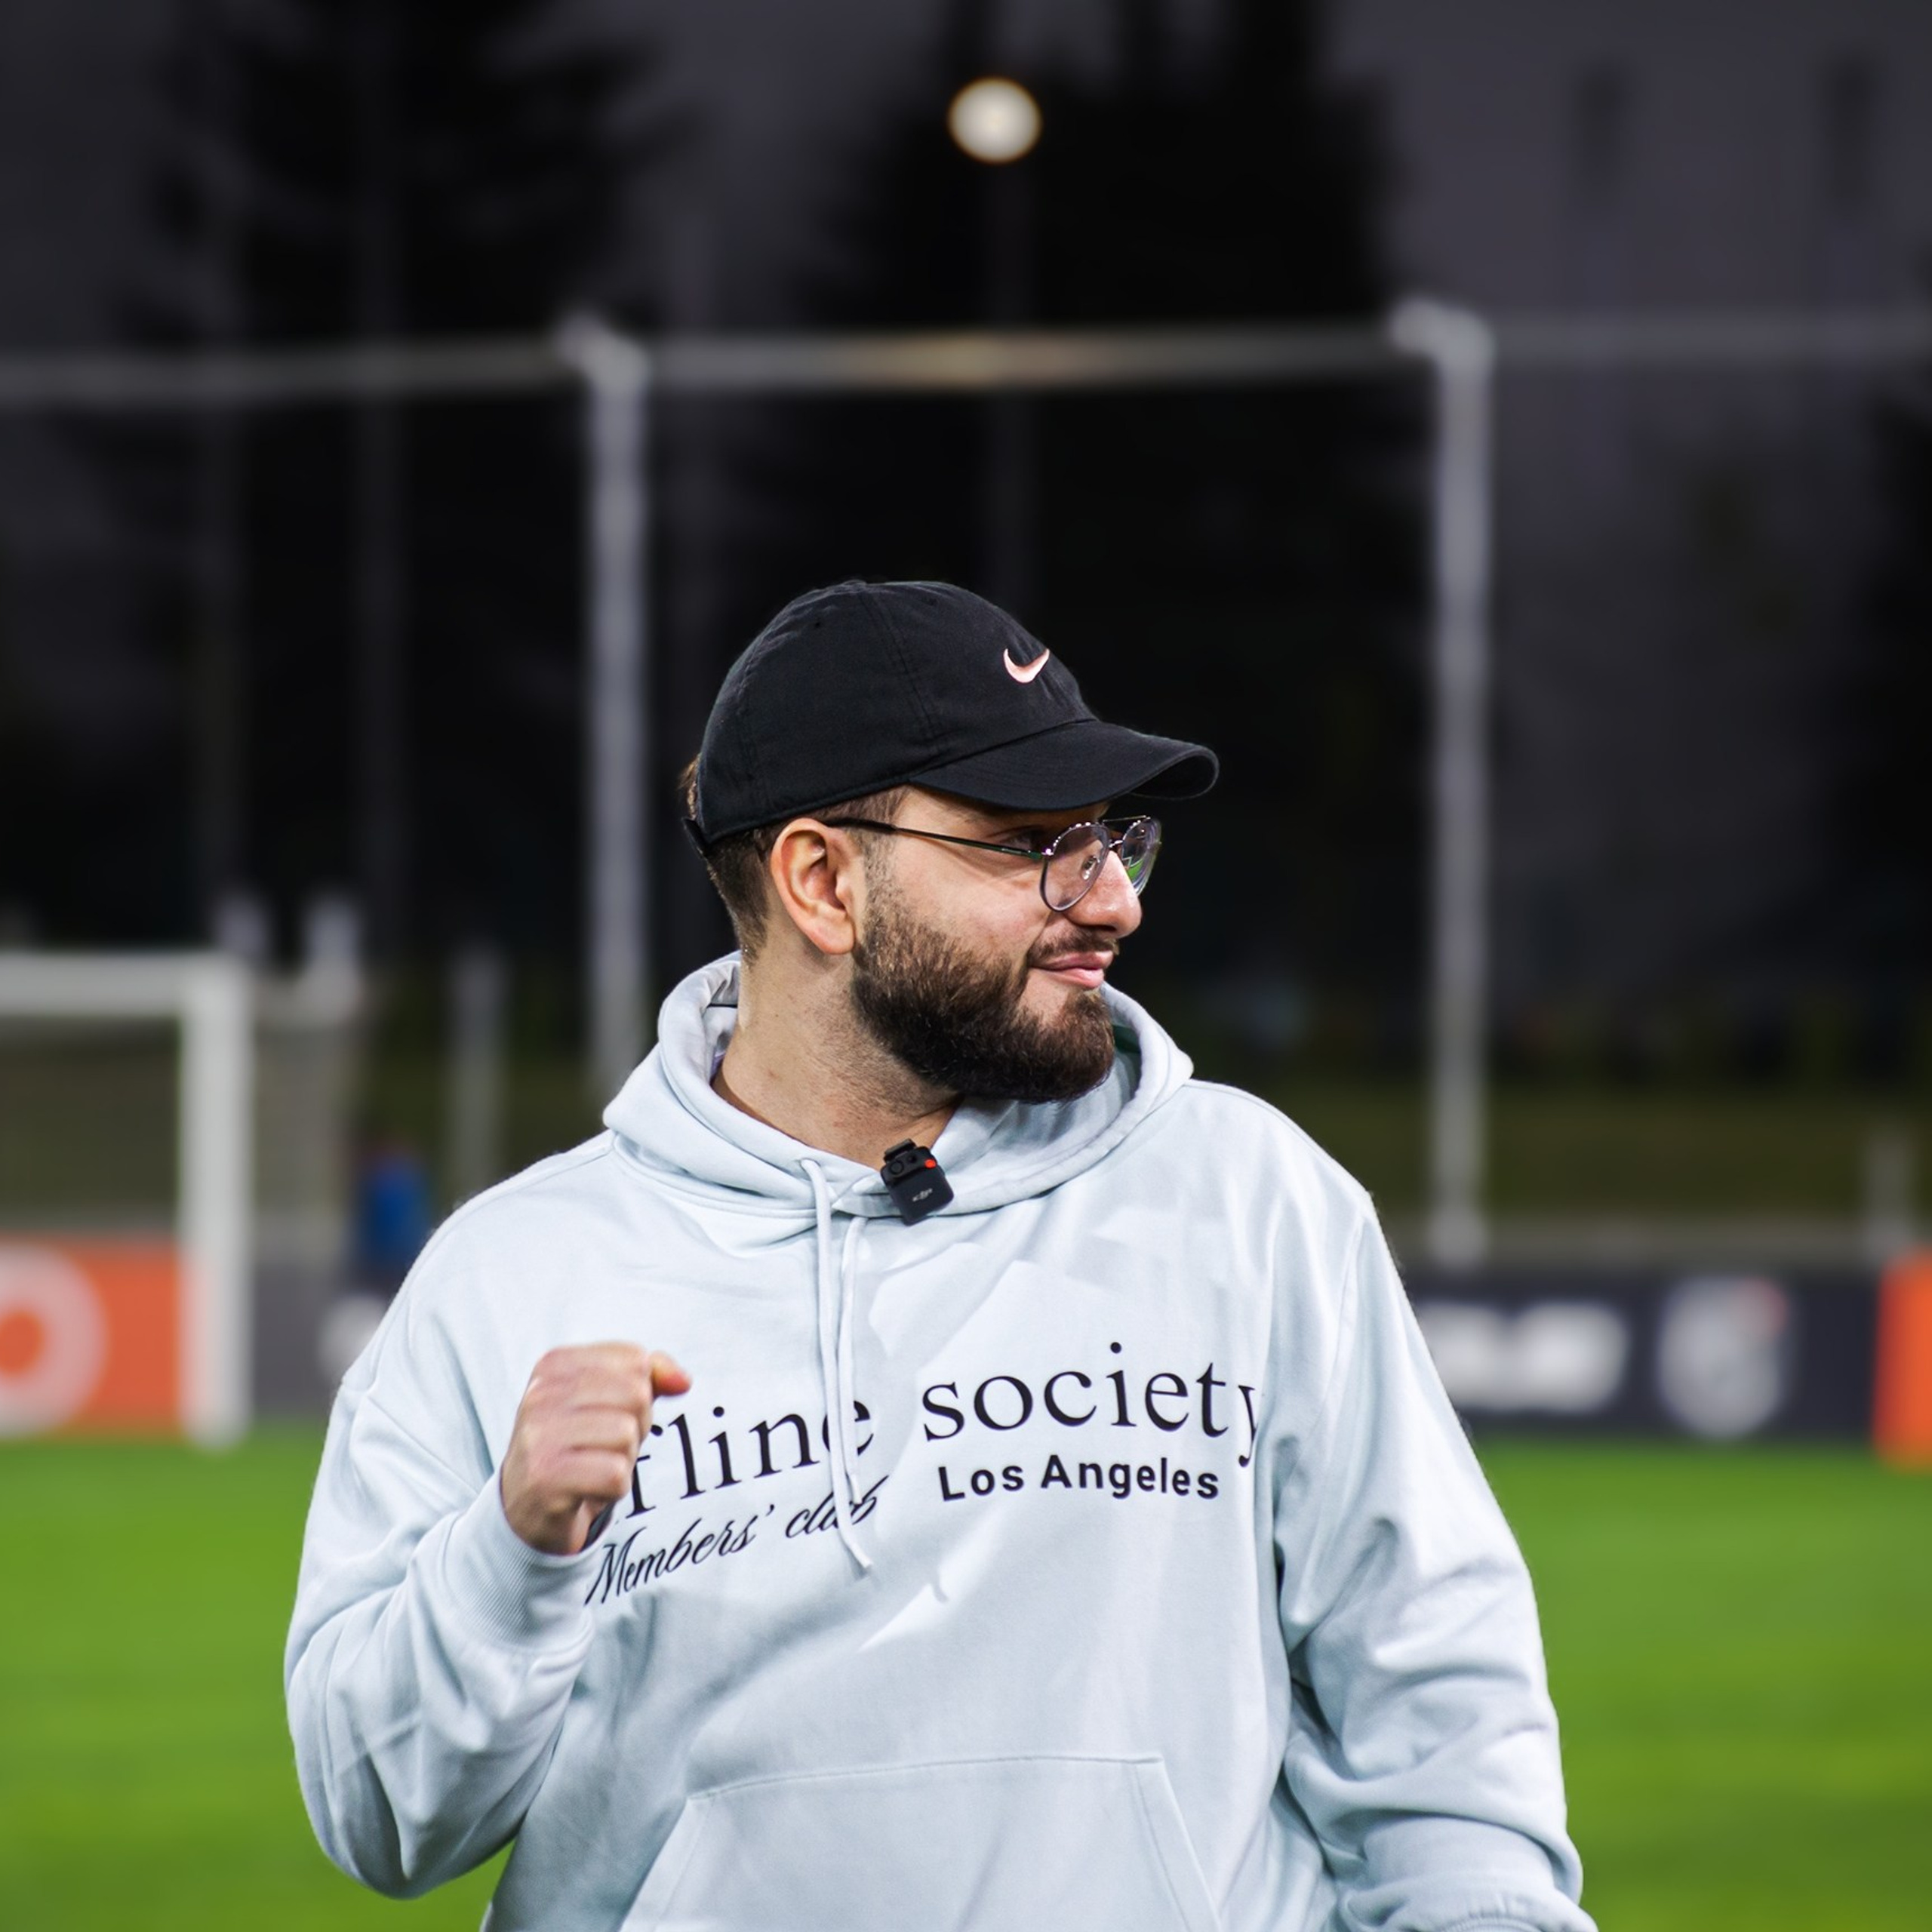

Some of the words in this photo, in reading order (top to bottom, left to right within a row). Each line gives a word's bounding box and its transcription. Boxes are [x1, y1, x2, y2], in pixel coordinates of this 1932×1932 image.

[619, 1399, 874, 1521] fline
[922, 1342, 1259, 1468] society
[937, 1465, 1025, 1502] Los
[1040, 1454, 1220, 1500] Angeles
